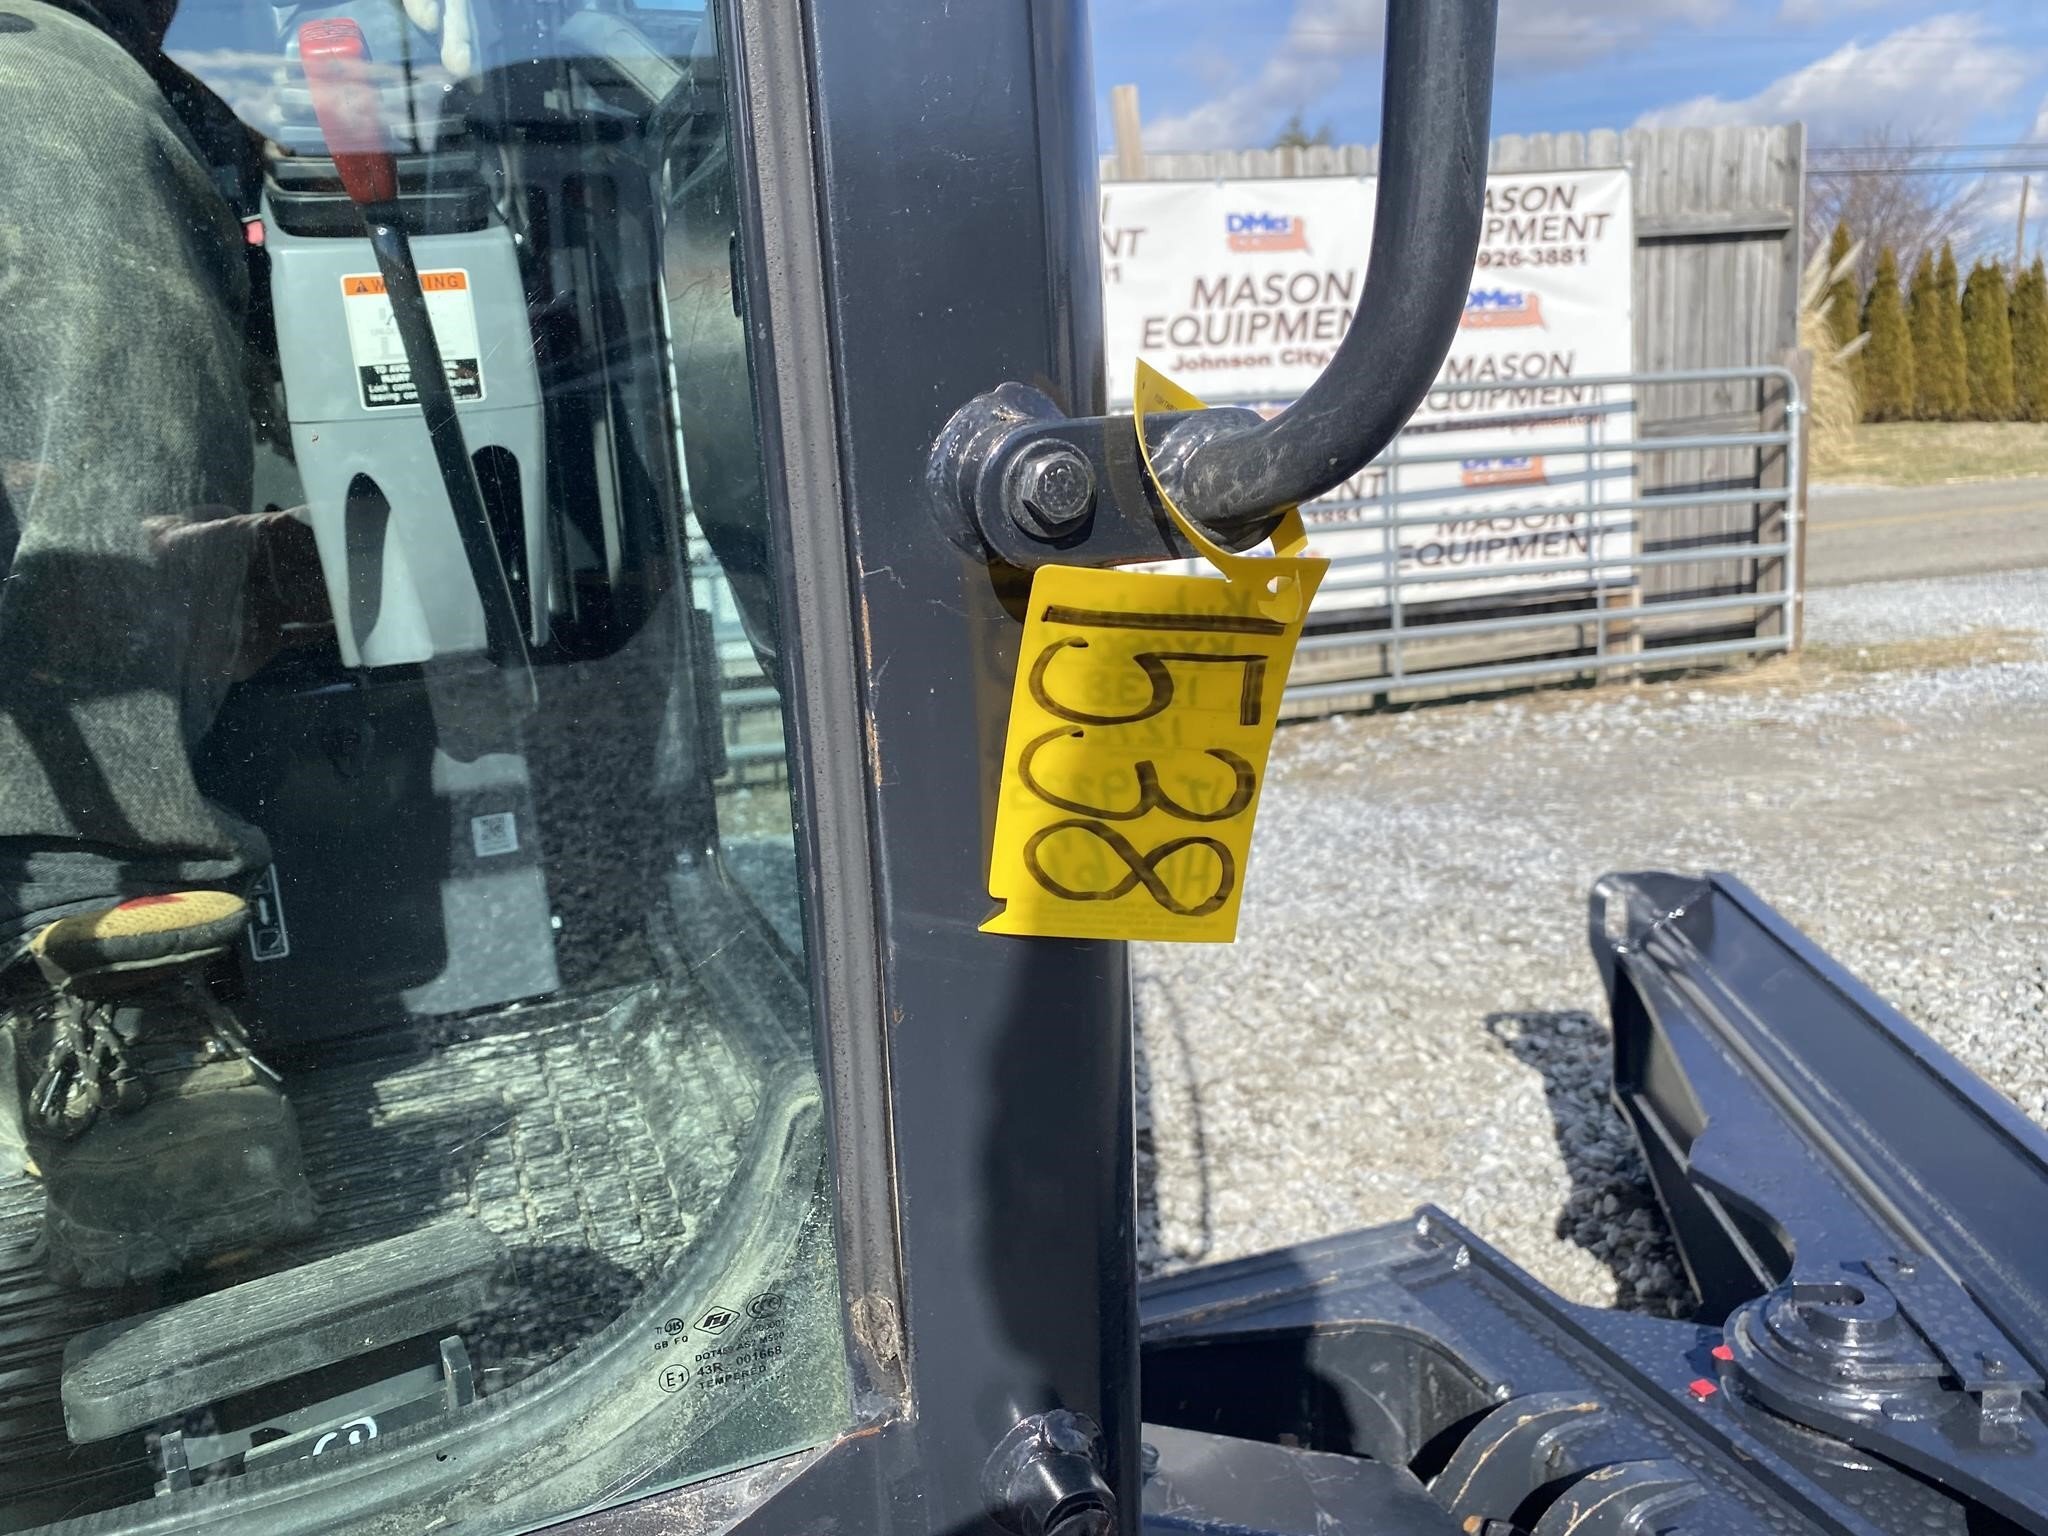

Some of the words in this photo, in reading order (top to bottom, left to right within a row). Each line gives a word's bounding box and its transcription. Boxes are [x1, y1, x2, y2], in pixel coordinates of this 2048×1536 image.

[1485, 184, 1578, 214] ASON
[1484, 213, 1612, 244] PMENT
[372, 274, 459, 293] WING
[1191, 269, 1358, 310] MASON
[1143, 308, 1354, 350] EQUIPMEN
[1170, 349, 1272, 373] Johnson
[1444, 352, 1576, 384] MASON
[1417, 384, 1600, 415] QUIPMENT
[1017, 604, 1288, 917] 1538
[654, 1341, 669, 1351] GB
[697, 1362, 723, 1377] 43R
[698, 1365, 767, 1390] TEMPERED
